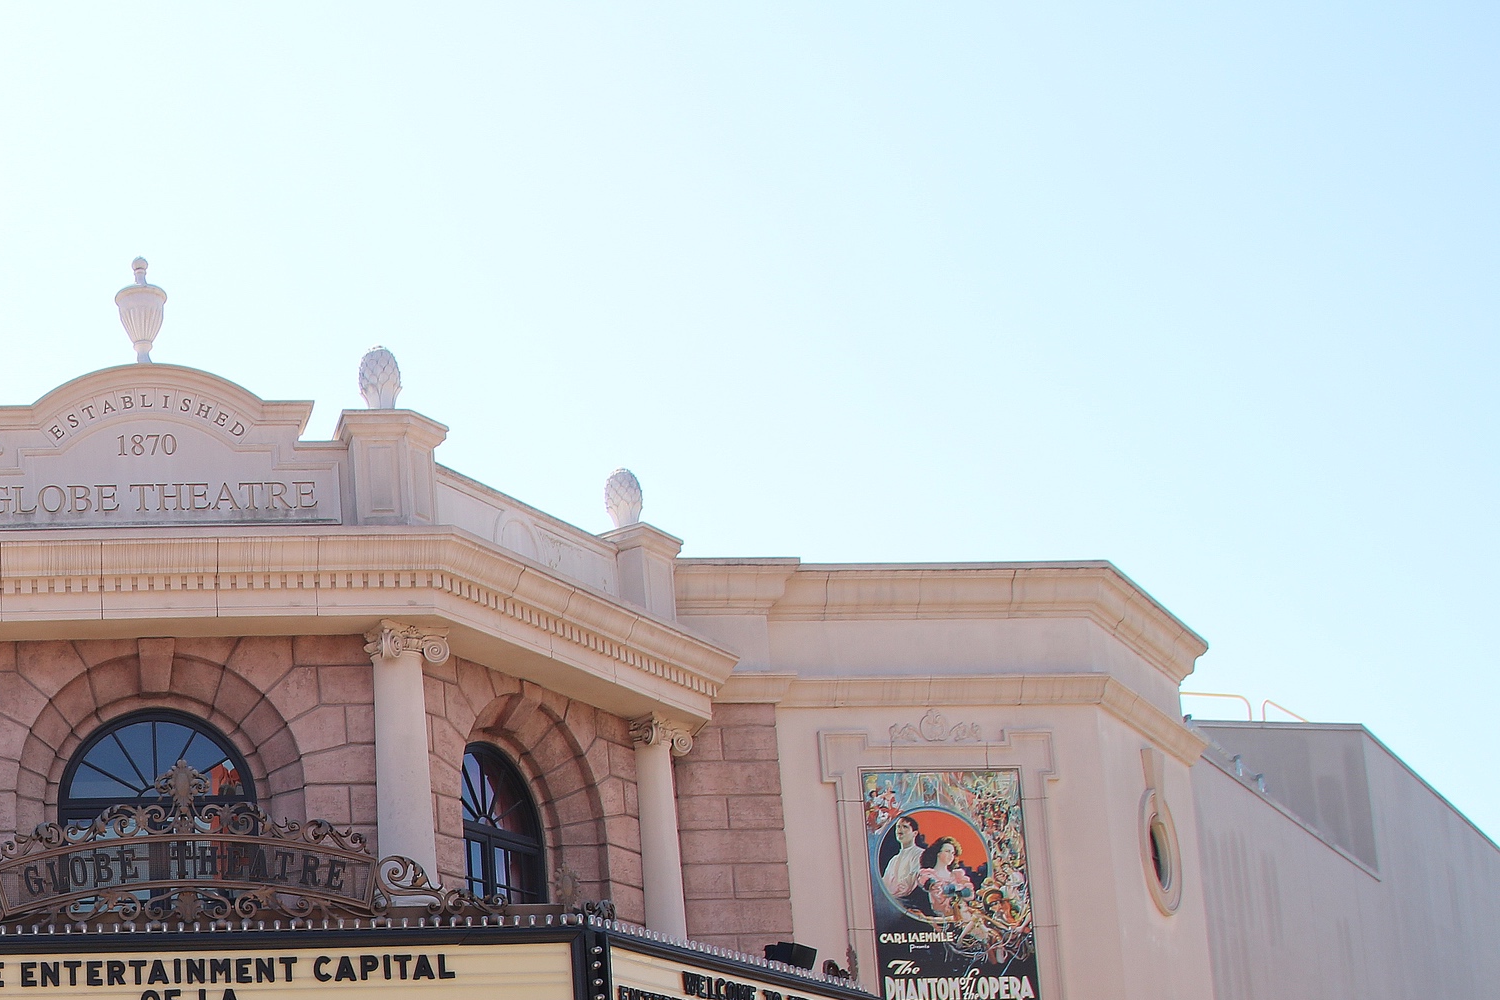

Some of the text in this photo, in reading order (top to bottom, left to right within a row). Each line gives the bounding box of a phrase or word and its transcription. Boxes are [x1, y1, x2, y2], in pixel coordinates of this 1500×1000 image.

[48, 393, 246, 441] ESTABLISHED
[117, 433, 178, 457] 1870
[129, 480, 319, 513] THEATRE
[23, 839, 348, 897] GLOBE THEATRE
[879, 931, 954, 944] CARL LAEMMLE
[21, 956, 297, 988] ENTERTAINMENT
[313, 953, 456, 982] CAPITAL
[887, 959, 920, 975] The
[959, 968, 980, 990] of
[963, 978, 980, 1000] the
